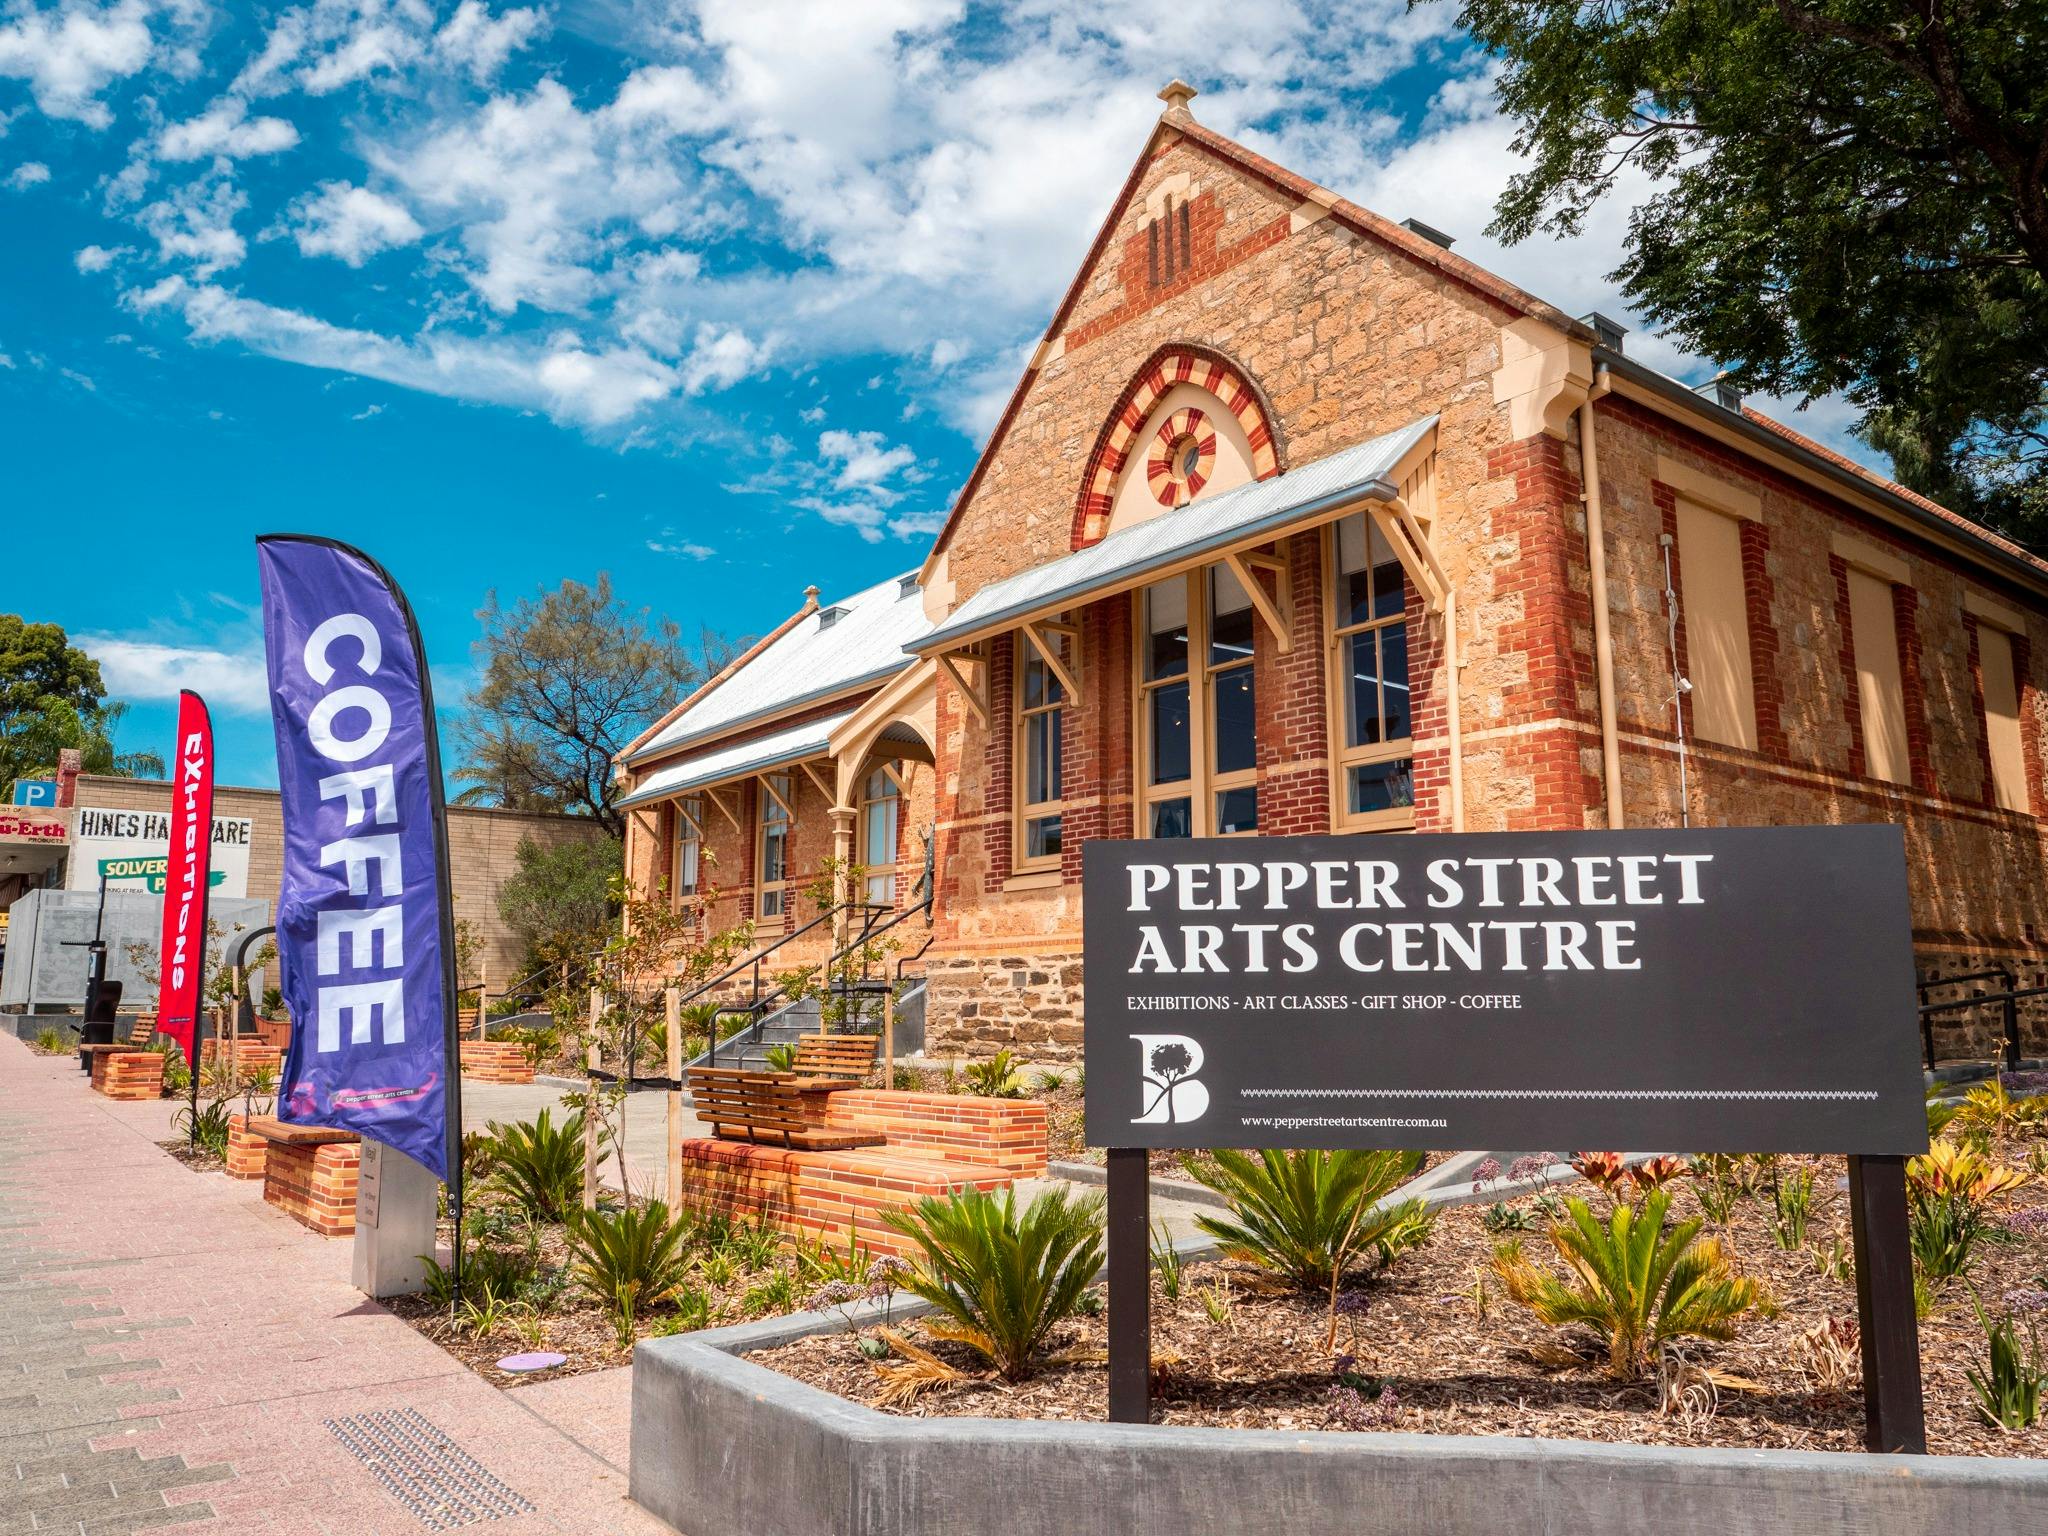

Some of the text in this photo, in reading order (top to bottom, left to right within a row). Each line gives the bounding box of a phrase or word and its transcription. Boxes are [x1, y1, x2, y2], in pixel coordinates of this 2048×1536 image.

[26, 785, 45, 806] P
[80, 811, 250, 845] HINES HAARE
[303, 613, 406, 1053] COFFEE
[105, 860, 168, 876] SOLVER
[172, 731, 205, 991] EXHIBITIONS
[1125, 853, 1714, 912] PEPPER STREET
[1127, 920, 1642, 974] ARTS CENTRE
[1126, 995, 1230, 1011] EXHIBITIONS
[1242, 995, 1277, 1010] ART
[1280, 995, 1349, 1010] CLASSES
[1360, 995, 1399, 1010] GIFT
[1402, 994, 1447, 1010] SHOP
[1459, 994, 1522, 1009] COFFEE
[346, 1095, 366, 1103] pepper
[1240, 1116, 1448, 1130] www.pepperstreetartscentre.com.au
